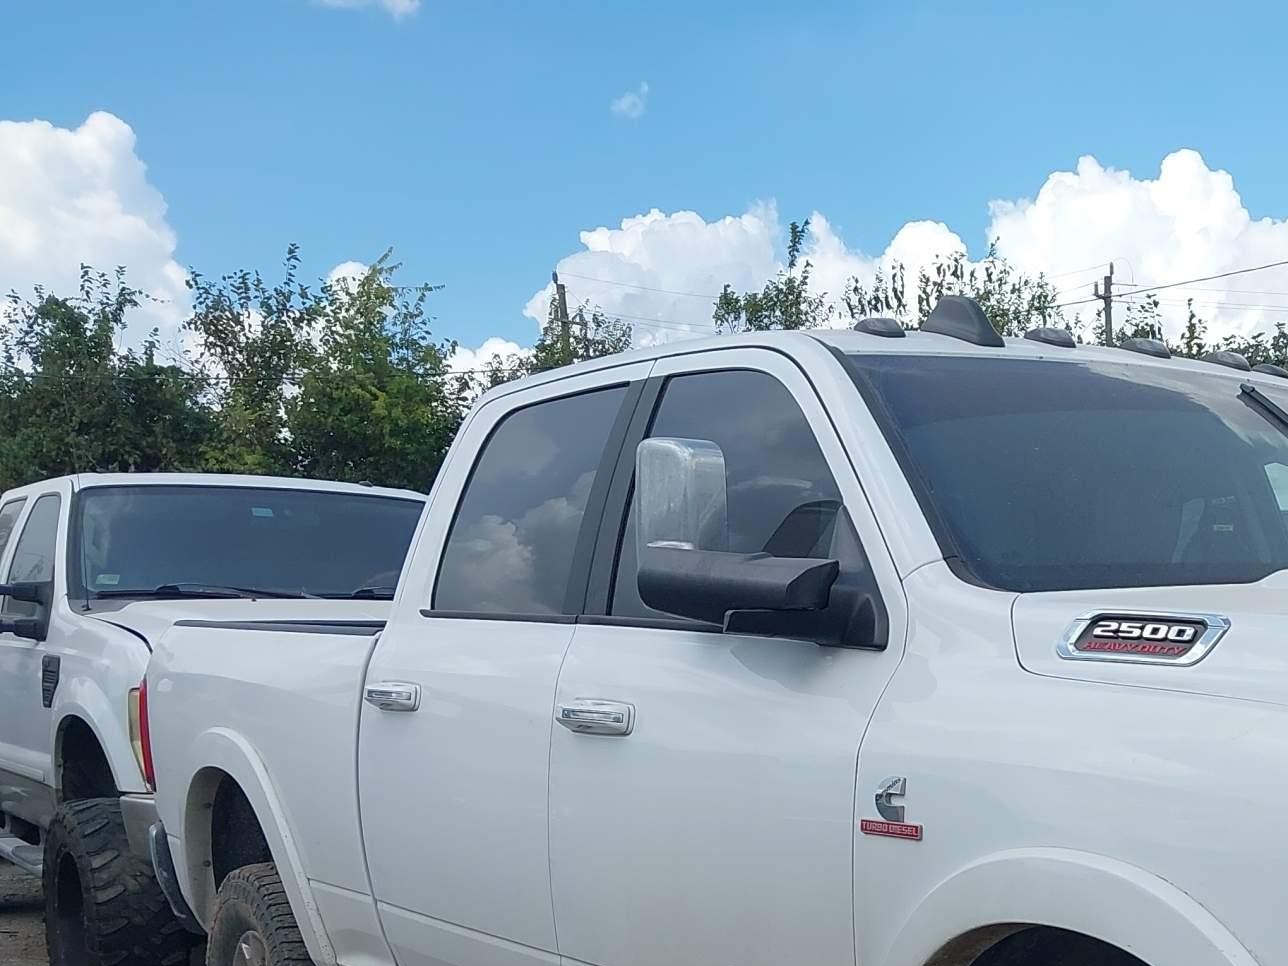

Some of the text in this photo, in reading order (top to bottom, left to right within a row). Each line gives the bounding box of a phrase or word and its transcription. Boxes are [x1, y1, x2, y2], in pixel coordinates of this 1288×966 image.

[1092, 620, 1198, 642] 2500
[1083, 641, 1186, 655] HEAVY DUTY
[862, 821, 917, 836] TURBO DIESEL
